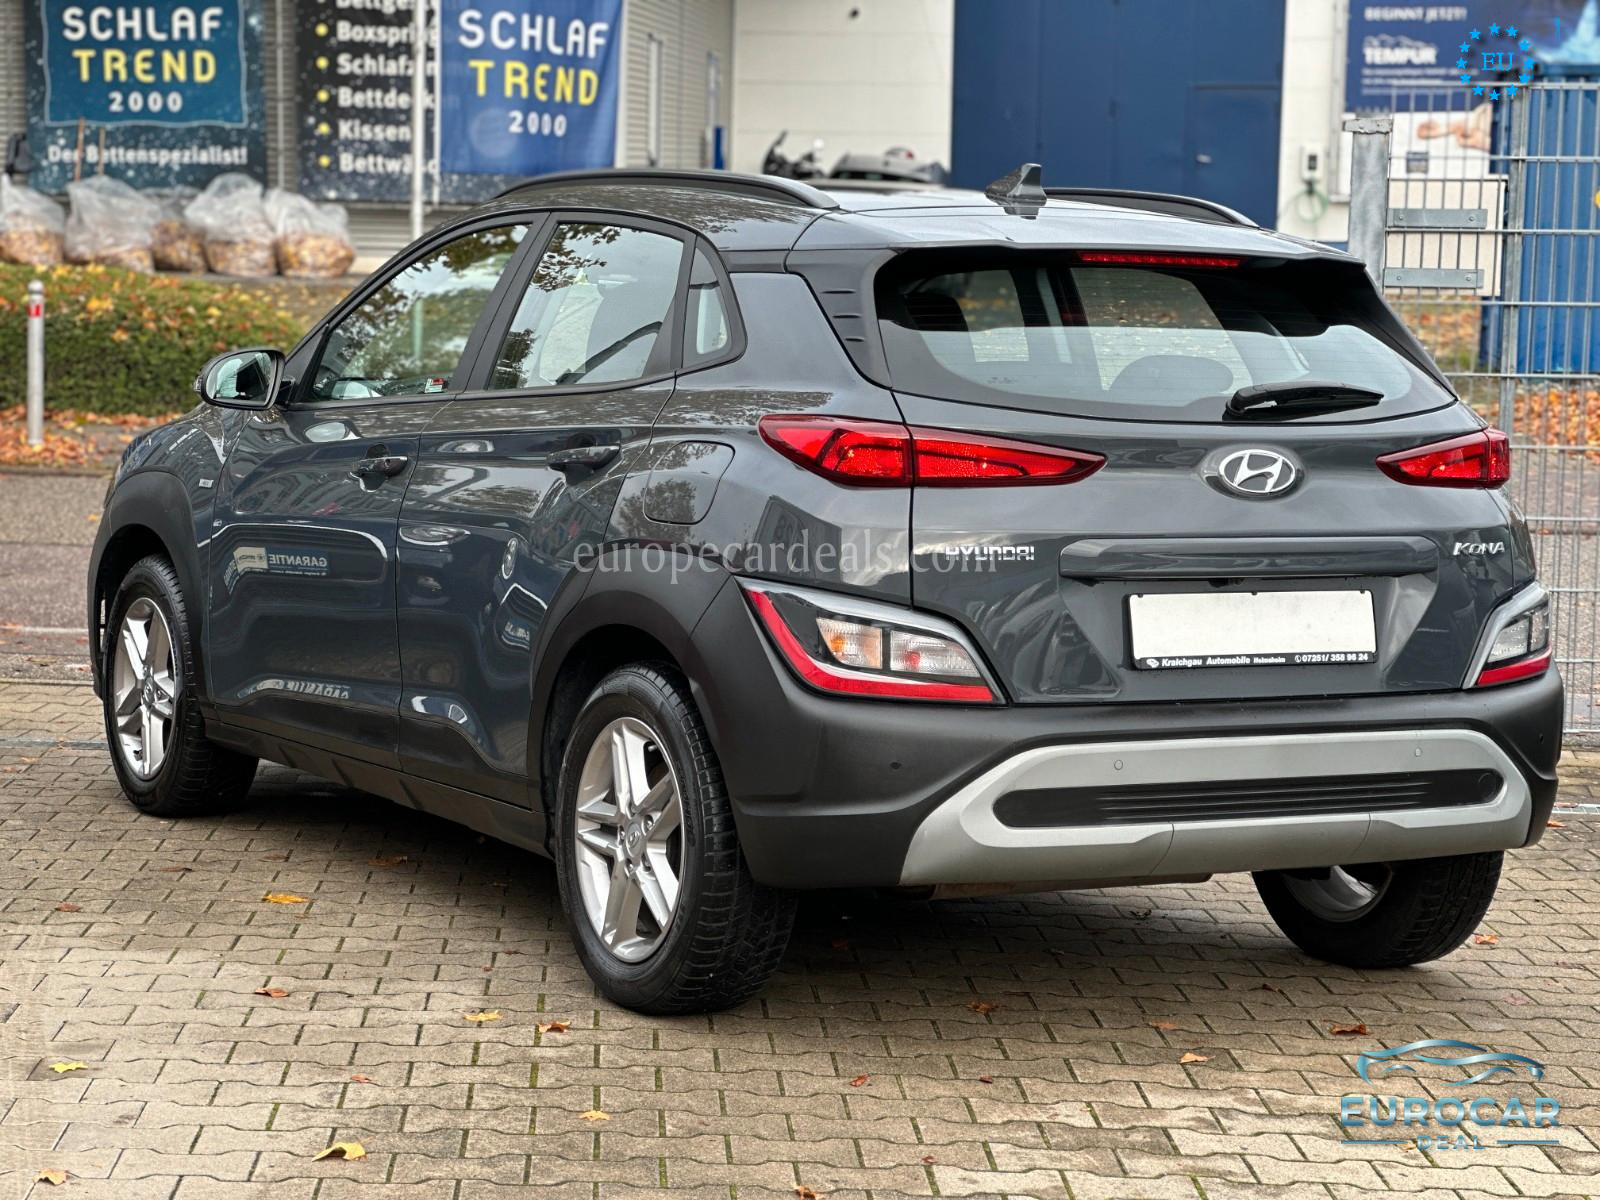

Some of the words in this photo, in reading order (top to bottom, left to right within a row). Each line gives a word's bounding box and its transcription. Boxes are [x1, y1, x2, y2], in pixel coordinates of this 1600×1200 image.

[62, 7, 223, 41] SCHLAF
[458, 9, 609, 59] SCHLAF
[72, 49, 216, 82] TREND
[1364, 47, 1437, 65] TEMPUR
[468, 59, 599, 106] TREND
[108, 91, 183, 112] 2000
[339, 118, 411, 142] Kissen
[508, 110, 567, 137] 2000
[945, 545, 1035, 561] HYUNDAI
[1453, 541, 1506, 556] KONA
[1161, 658, 1203, 667] Kraichgau
[1206, 656, 1251, 665] Automobile
